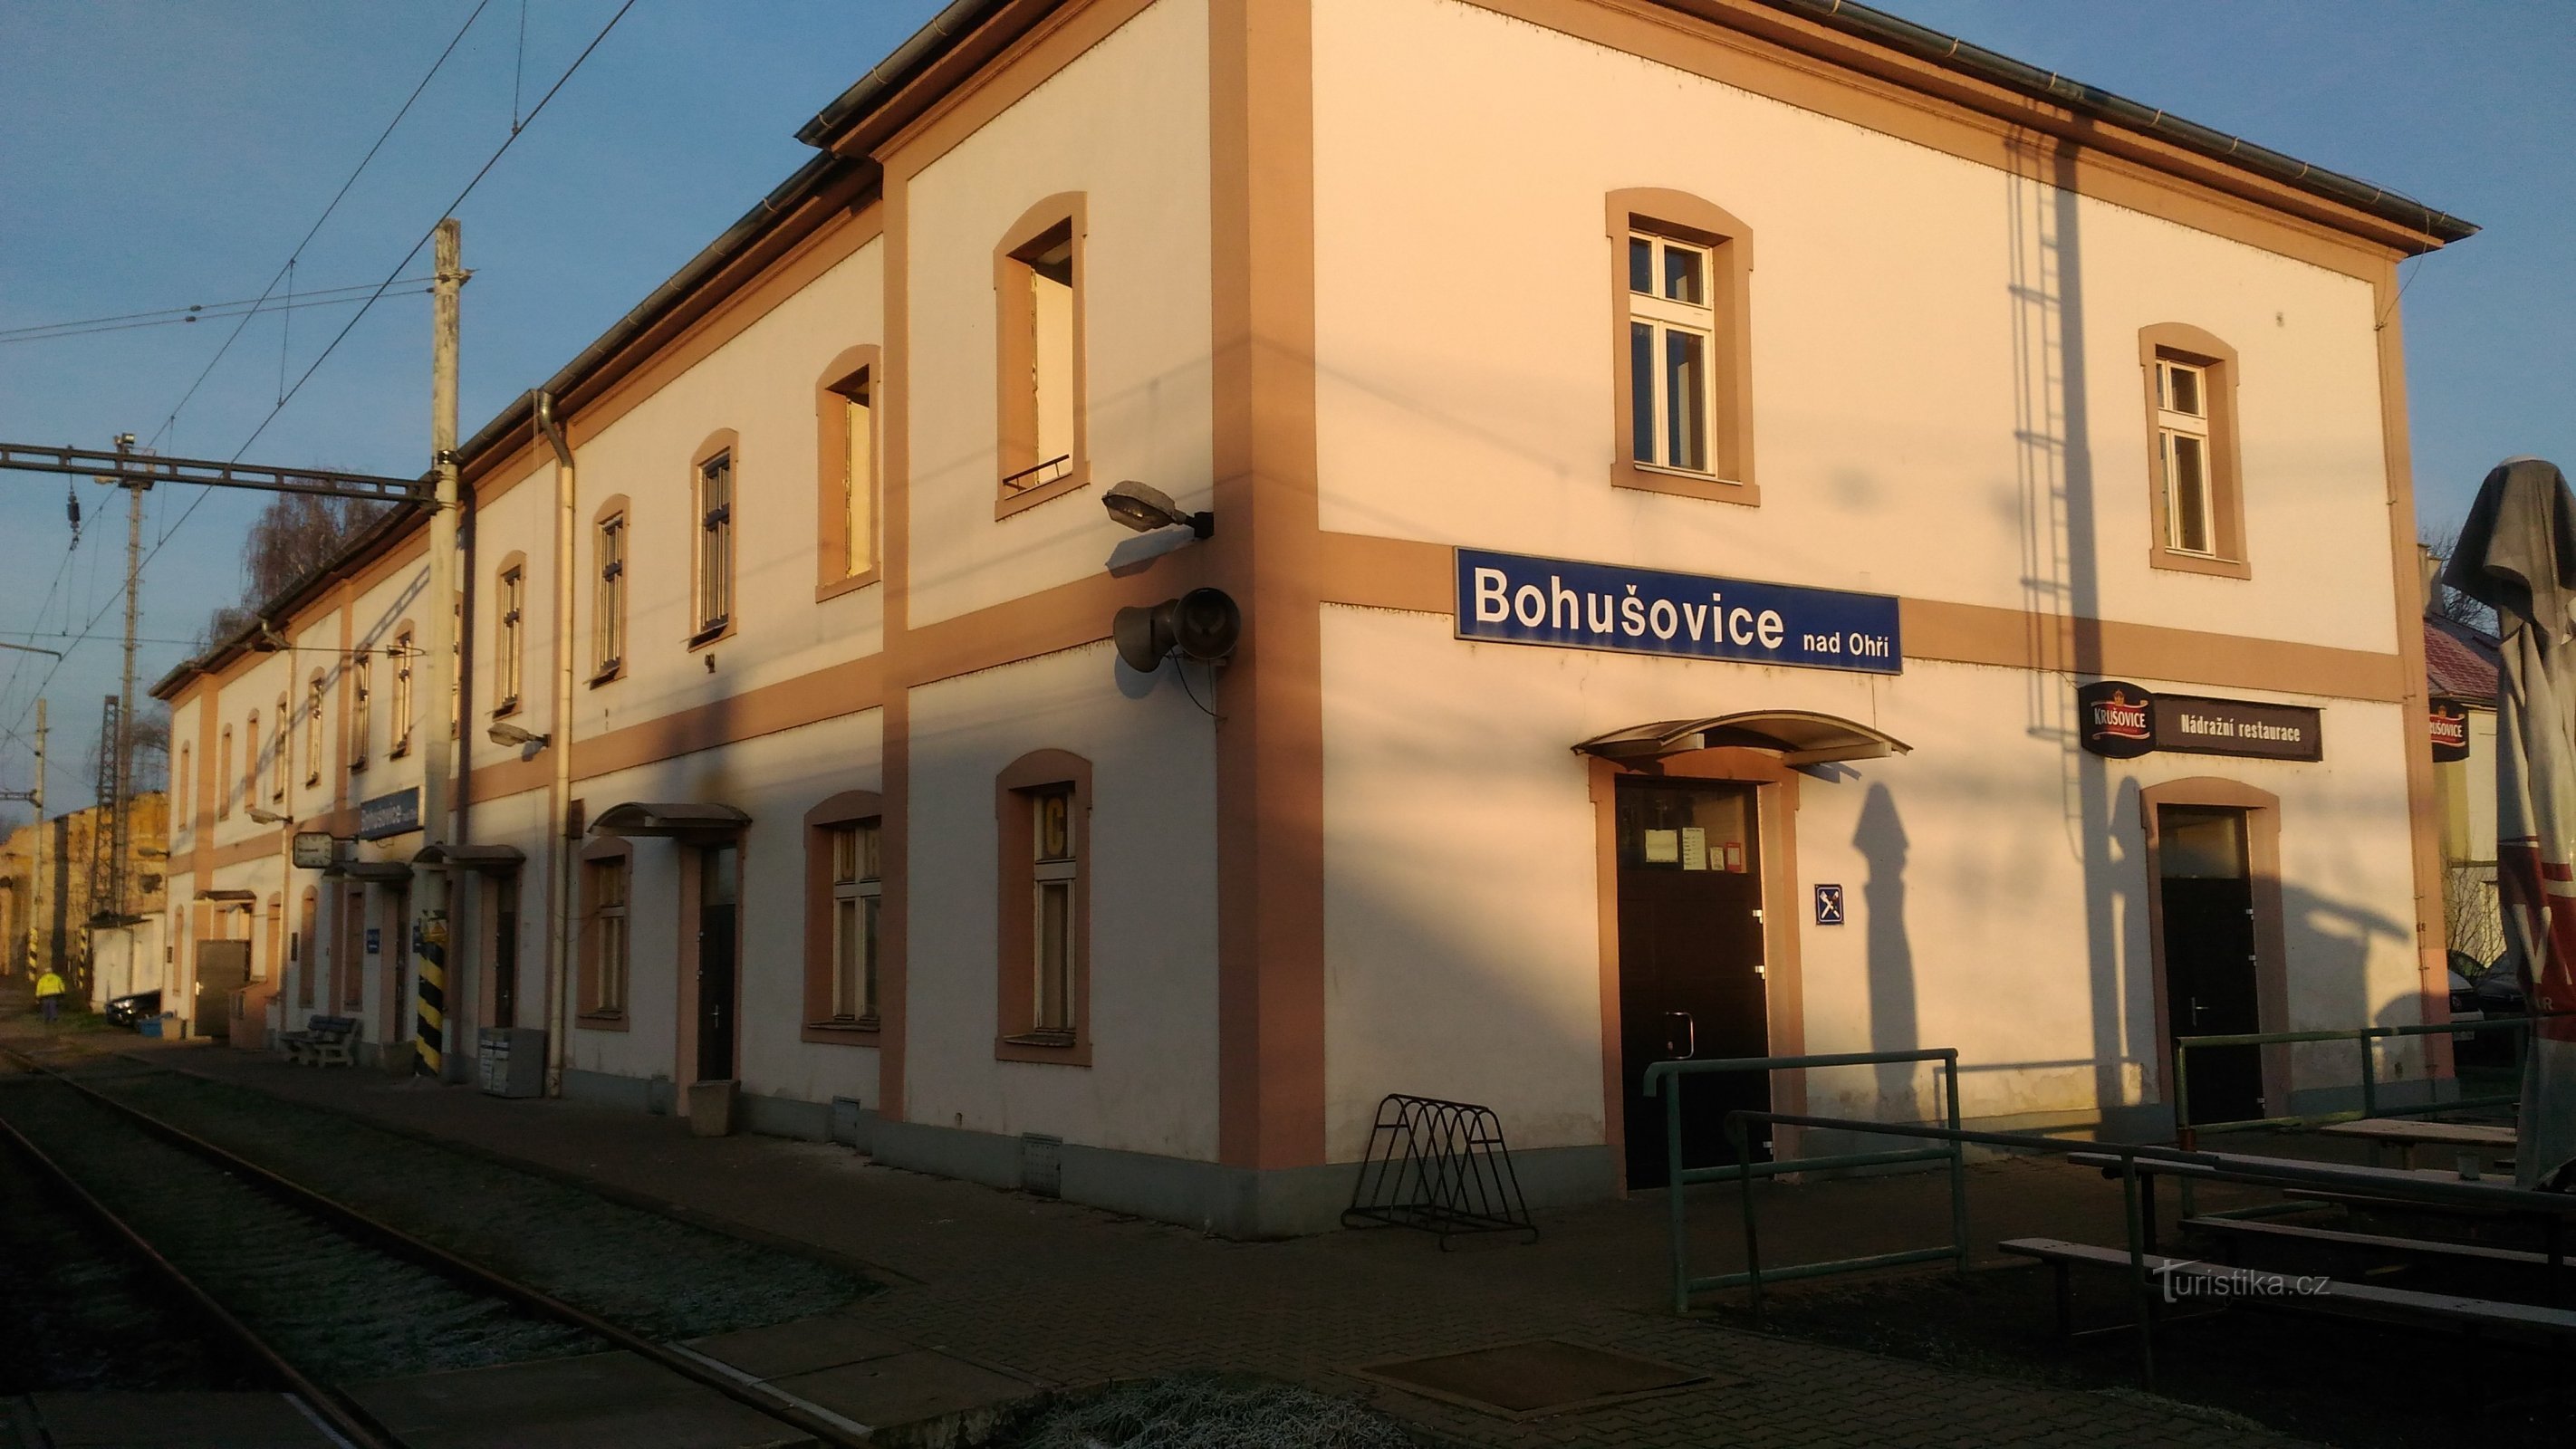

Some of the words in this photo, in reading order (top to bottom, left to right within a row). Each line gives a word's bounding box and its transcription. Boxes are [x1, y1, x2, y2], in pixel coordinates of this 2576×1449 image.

[1474, 566, 1784, 649] Bohušovice
[1802, 631, 1841, 654] nad
[1849, 632, 1889, 657] Ohří
[2094, 706, 2146, 728] KRUŠOVICE
[2180, 714, 2235, 737] Nádražní
[2238, 721, 2301, 743] restaurace
[2429, 720, 2463, 738] RUŠOVICE
